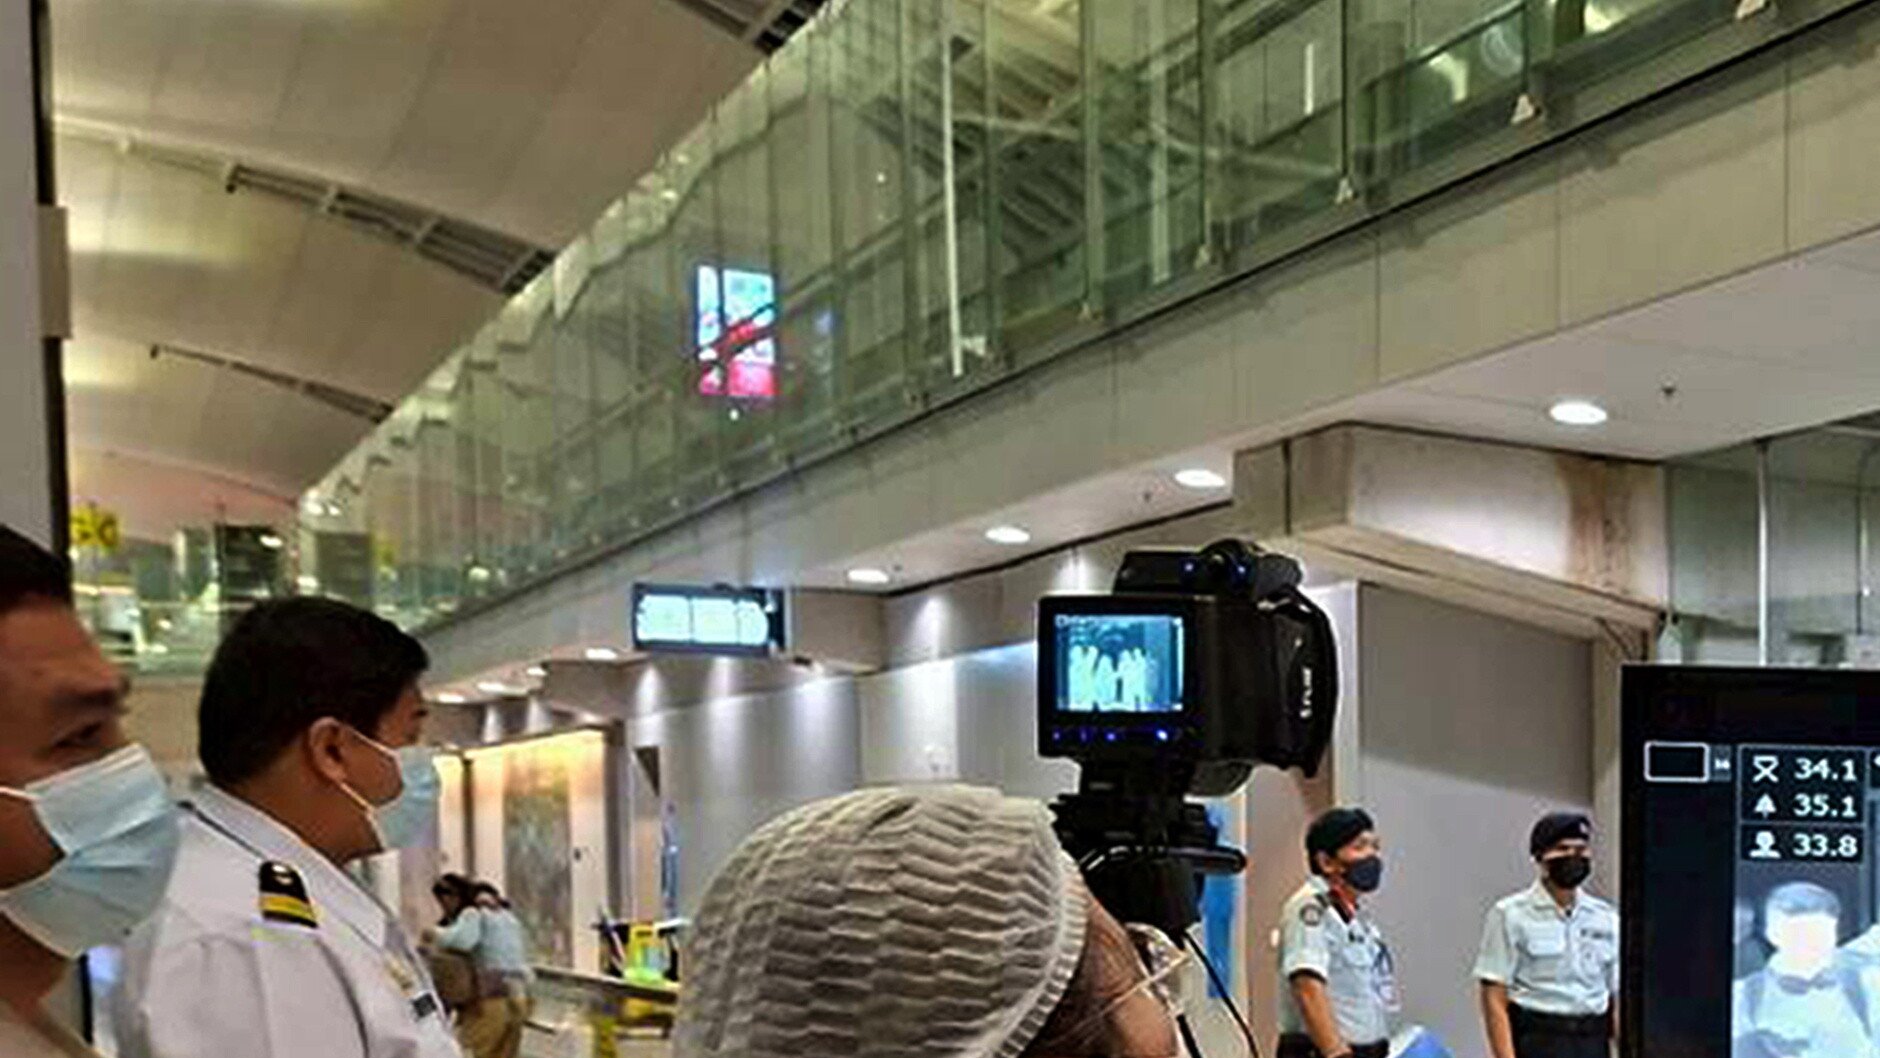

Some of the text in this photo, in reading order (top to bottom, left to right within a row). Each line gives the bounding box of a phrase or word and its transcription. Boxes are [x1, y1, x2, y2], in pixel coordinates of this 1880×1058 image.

[1794, 757, 1857, 782] 34.1
[1793, 794, 1857, 818] 35.1
[1793, 833, 1858, 858] 33.8
